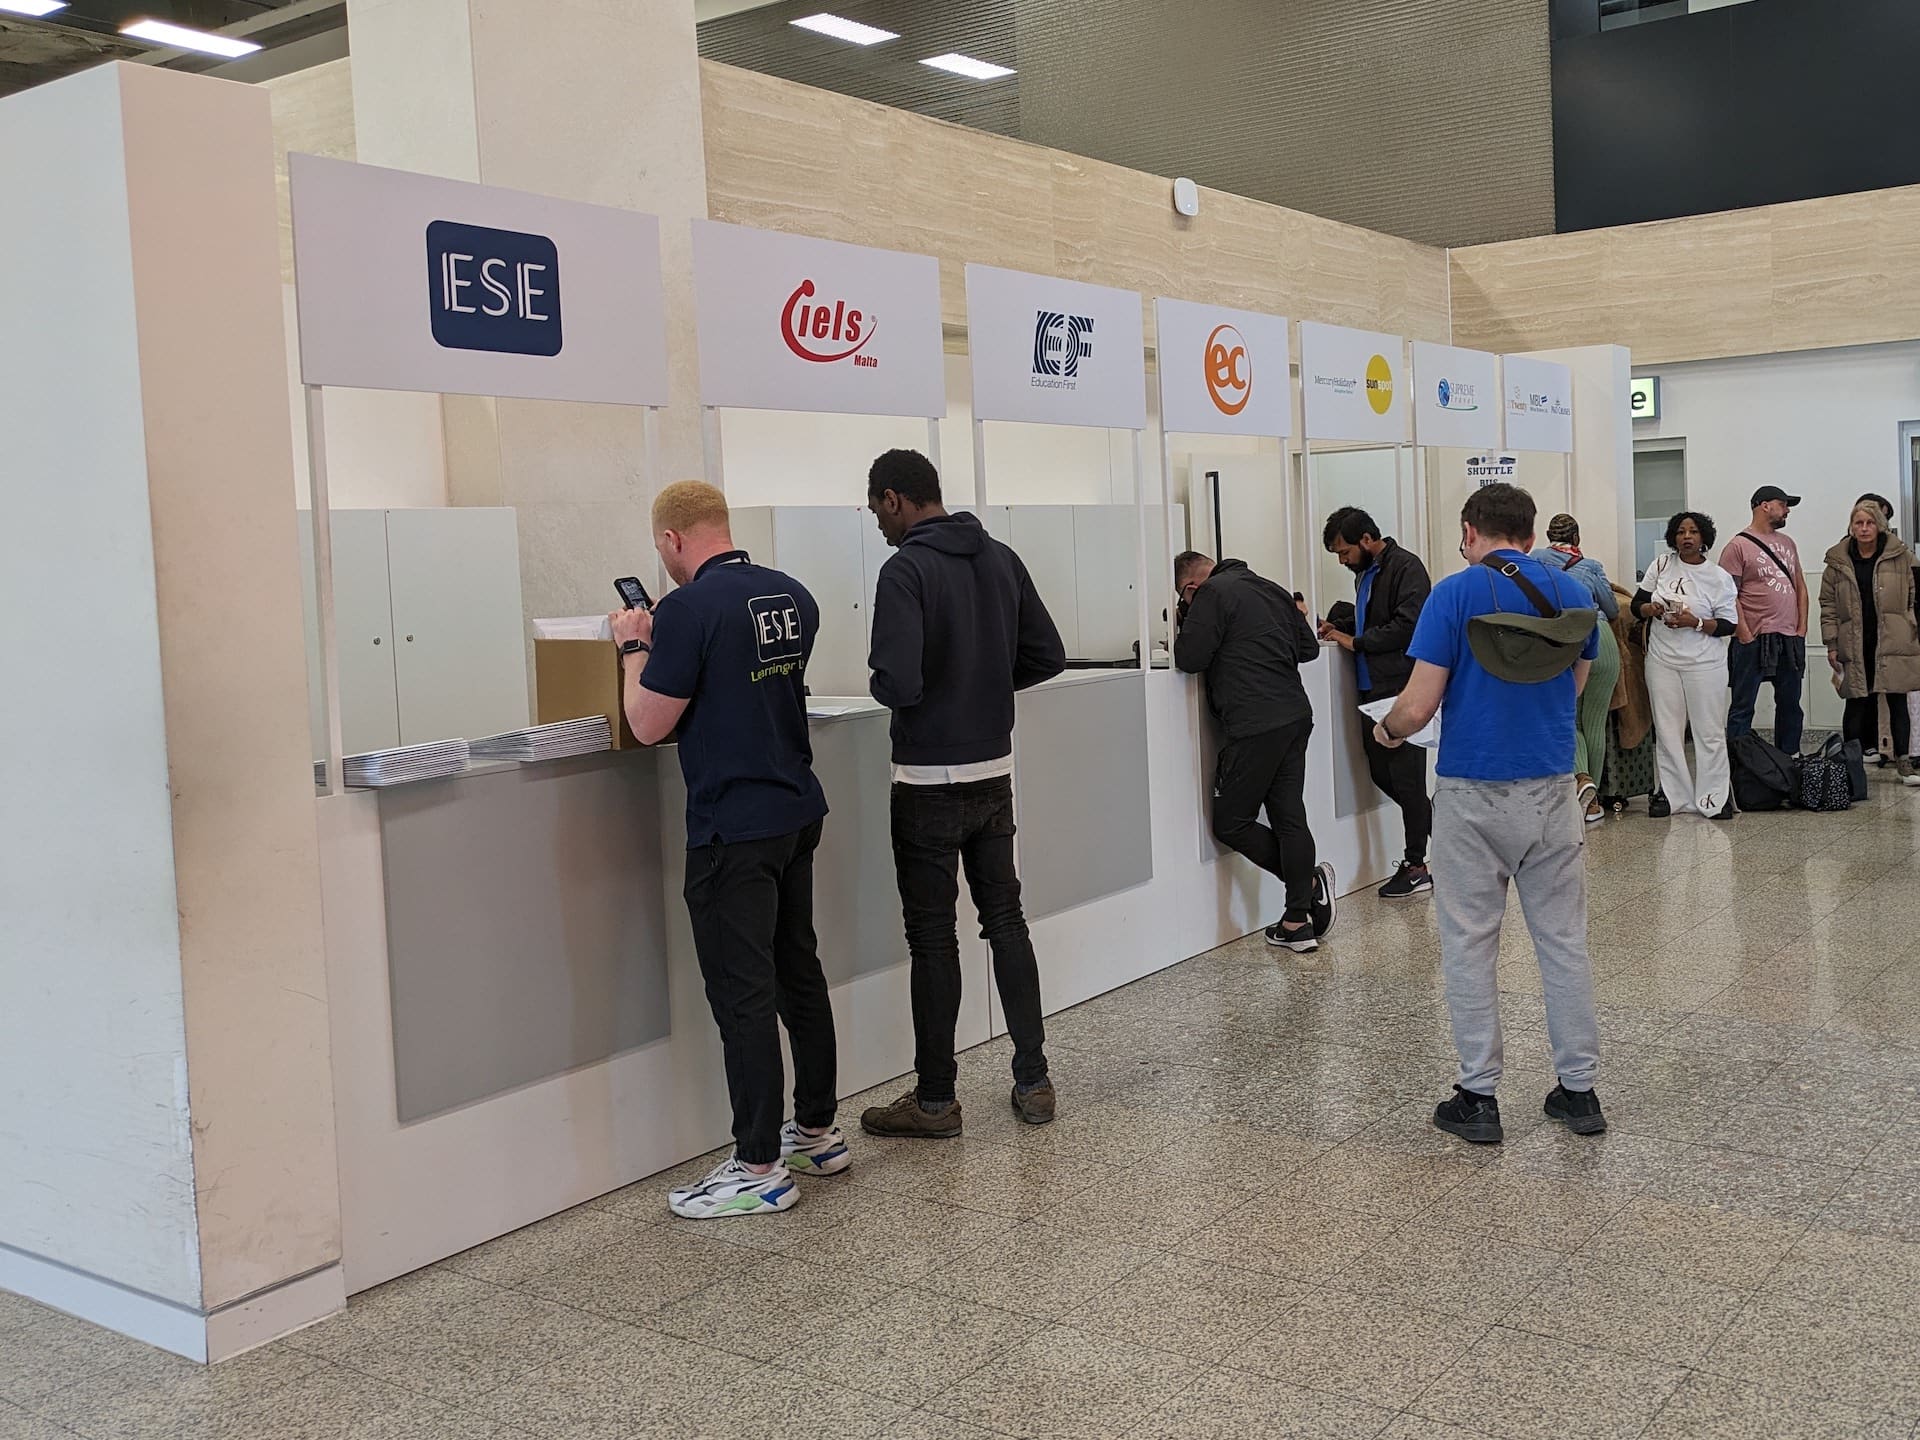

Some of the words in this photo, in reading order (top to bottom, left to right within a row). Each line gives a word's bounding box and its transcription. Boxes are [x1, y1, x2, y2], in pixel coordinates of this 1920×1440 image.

[442, 252, 549, 321] ESE
[854, 354, 878, 368] Malta
[1206, 343, 1246, 390] ec
[1031, 376, 1063, 389] Education
[1063, 380, 1076, 390] First
[1450, 382, 1475, 396] SUPREME
[1631, 391, 1647, 410] e
[1467, 466, 1513, 476] SHUTTLE
[1757, 565, 1774, 577] NYC
[757, 607, 799, 645] ESE
